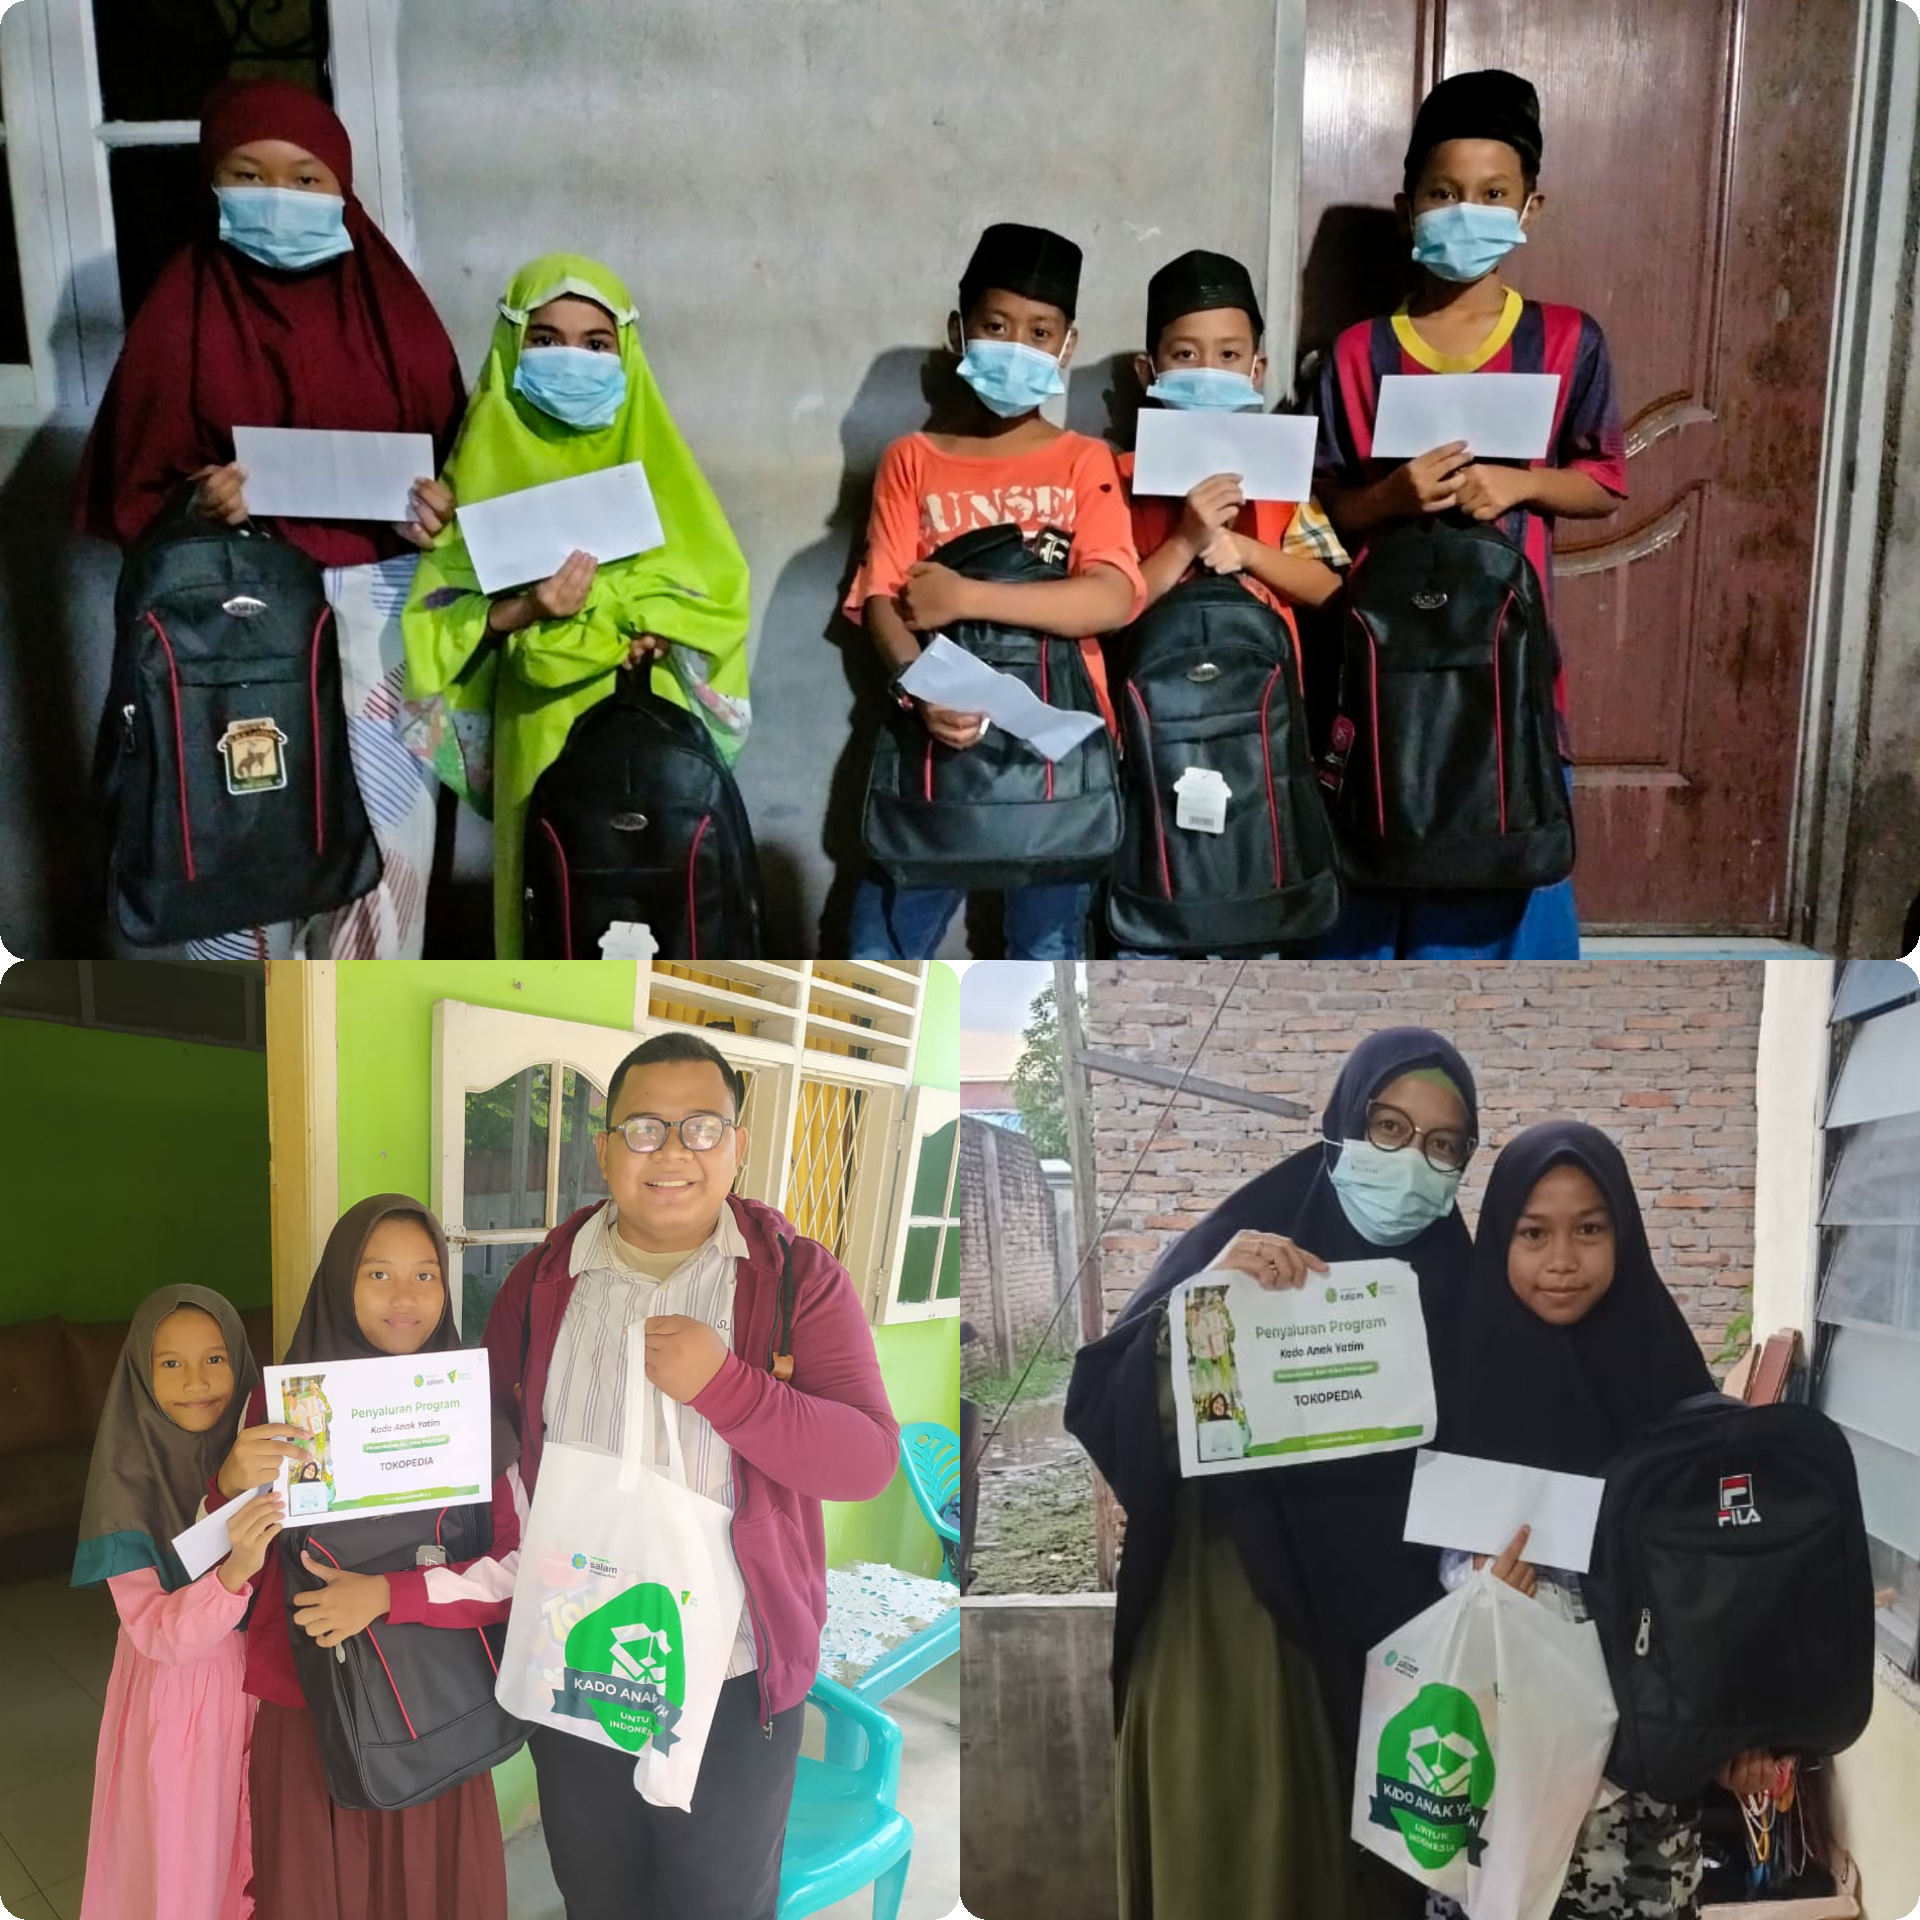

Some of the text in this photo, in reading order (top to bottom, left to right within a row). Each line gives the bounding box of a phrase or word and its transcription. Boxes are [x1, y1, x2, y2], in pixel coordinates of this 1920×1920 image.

[1255, 1316, 1387, 1341] Penyaluran Program
[1334, 1340, 1364, 1353] Yatim
[1293, 1388, 1362, 1407] TOKOPEDIA
[351, 1399, 460, 1420] Penyaluran Program
[370, 1418, 441, 1435] Kado Anak Yatim
[380, 1456, 434, 1471] TOKOPEDIA
[1718, 1507, 1762, 1528] FILA
[590, 1562, 618, 1575] salam
[574, 1677, 617, 1696] KADO
[620, 1711, 651, 1724] UNTU
[609, 1720, 655, 1737] INDONES
[1415, 1795, 1455, 1818] ANAK
